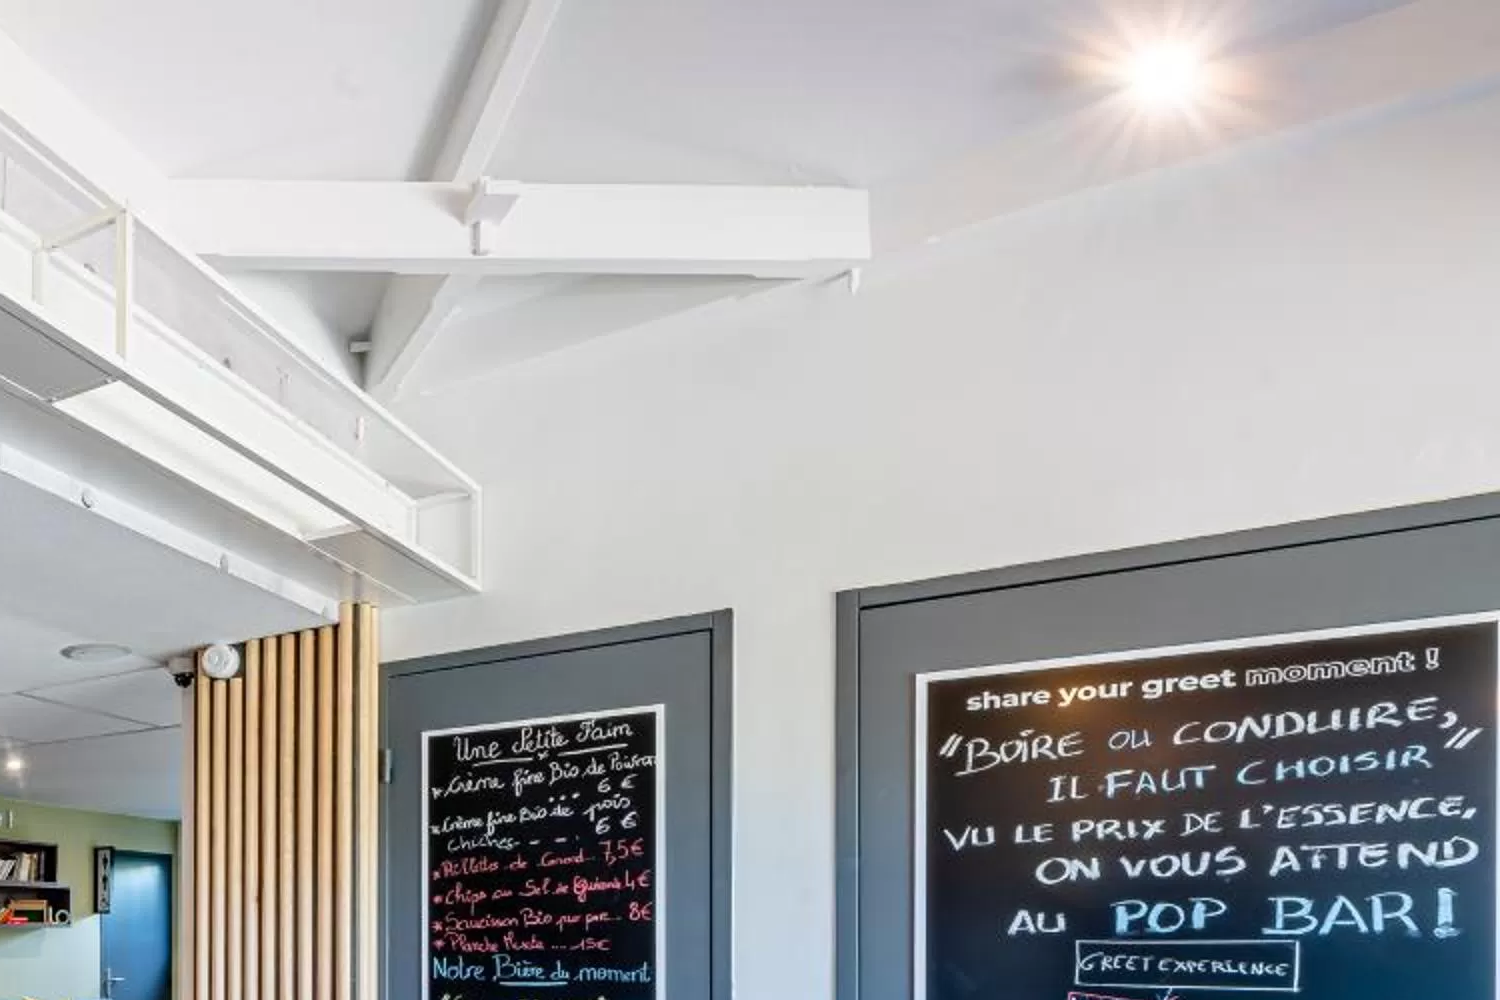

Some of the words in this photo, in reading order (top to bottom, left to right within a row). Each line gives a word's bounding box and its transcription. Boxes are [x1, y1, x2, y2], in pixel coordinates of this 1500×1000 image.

[965, 685, 1050, 712] share
[1055, 682, 1133, 709] your
[1141, 670, 1236, 700] greet
[1244, 650, 1415, 686] moment
[453, 736, 500, 761] Une
[549, 761, 579, 786] Bio
[1046, 774, 1090, 802] IL
[1102, 764, 1216, 799] FAUT
[943, 825, 995, 852] VU
[1014, 821, 1054, 844] LE
[1071, 816, 1168, 843] PRIX
[1181, 810, 1224, 837] DE
[1034, 855, 1101, 886] ON
[1120, 845, 1247, 879] VOUS
[1269, 835, 1480, 877] ATTEND
[1008, 908, 1067, 936] AU
[1113, 896, 1227, 934] POP
[433, 956, 487, 982] Notre
[550, 960, 570, 981] du
[574, 961, 652, 983] moment
[1079, 950, 1153, 973] GREET
[1158, 955, 1290, 978] EXPERIENCE
